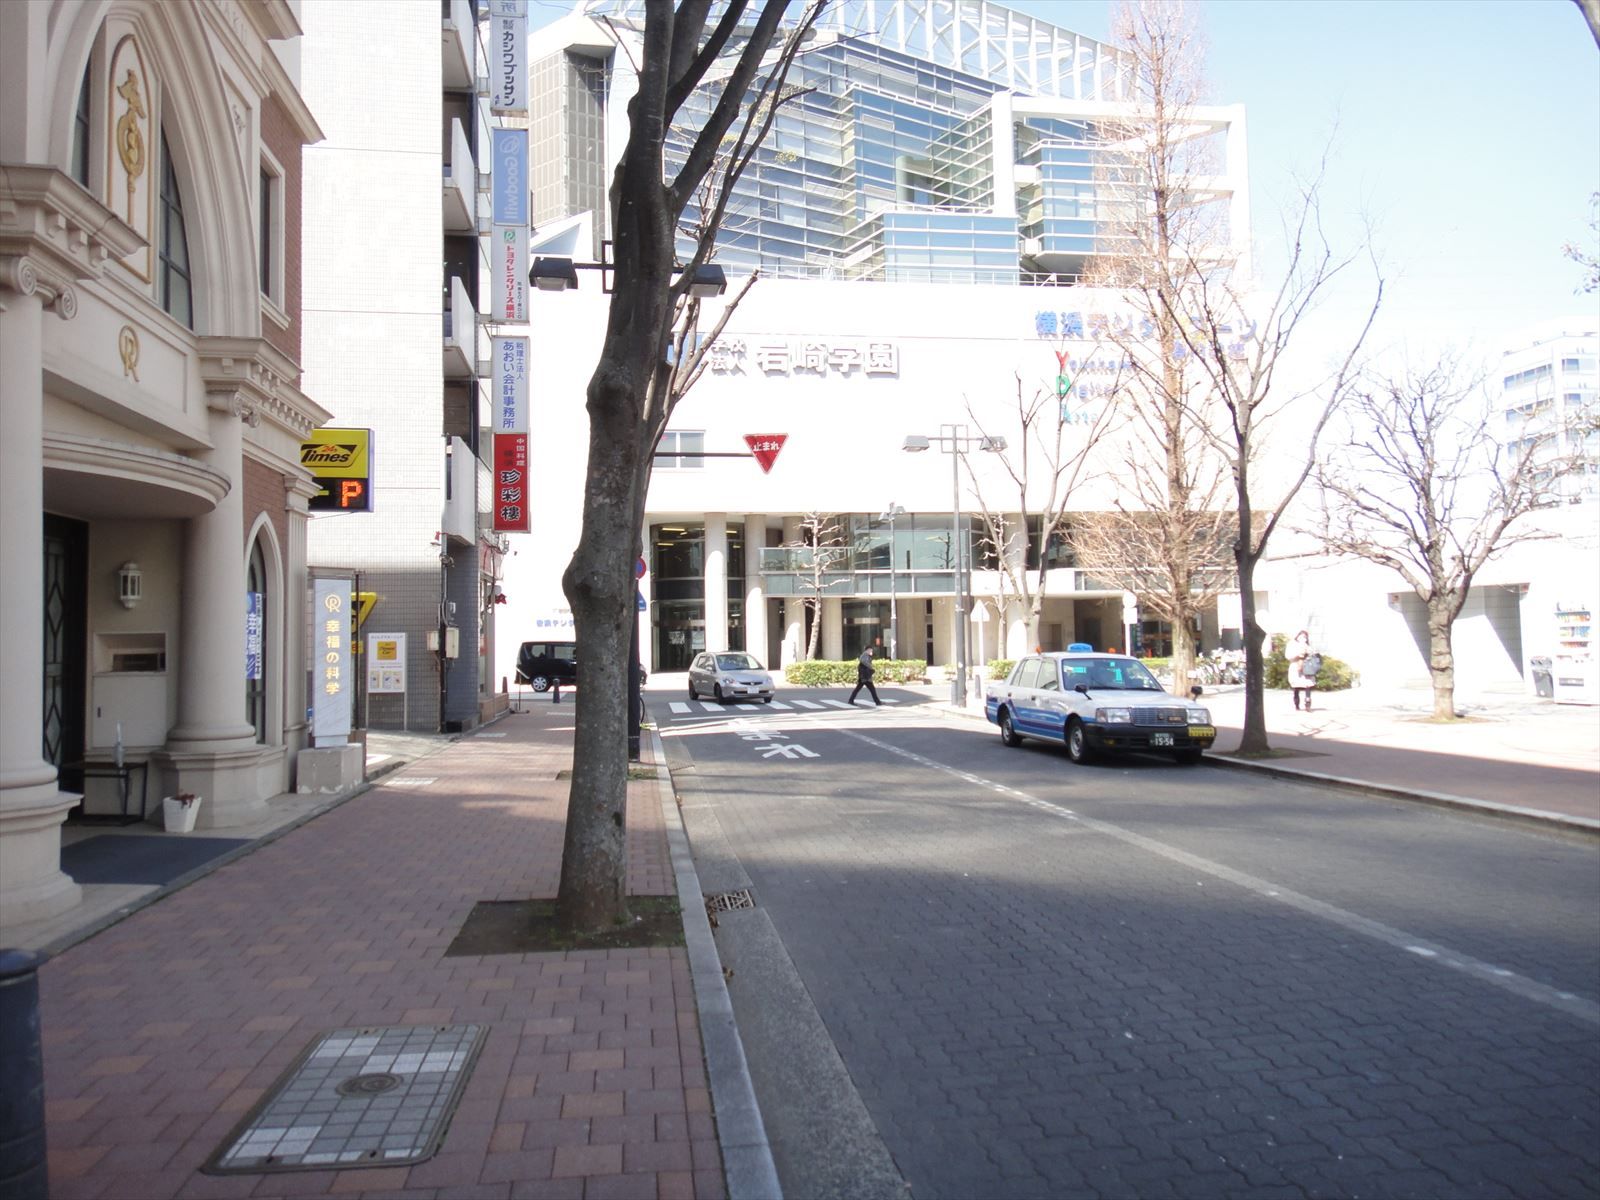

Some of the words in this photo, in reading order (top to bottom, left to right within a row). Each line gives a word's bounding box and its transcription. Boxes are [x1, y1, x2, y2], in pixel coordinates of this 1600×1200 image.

[502, 340, 516, 429] あおい会計事務所
[301, 448, 351, 463] Times
[753, 441, 780, 451] 止まれ
[342, 480, 362, 508] P
[326, 620, 341, 695] 幸福の科学
